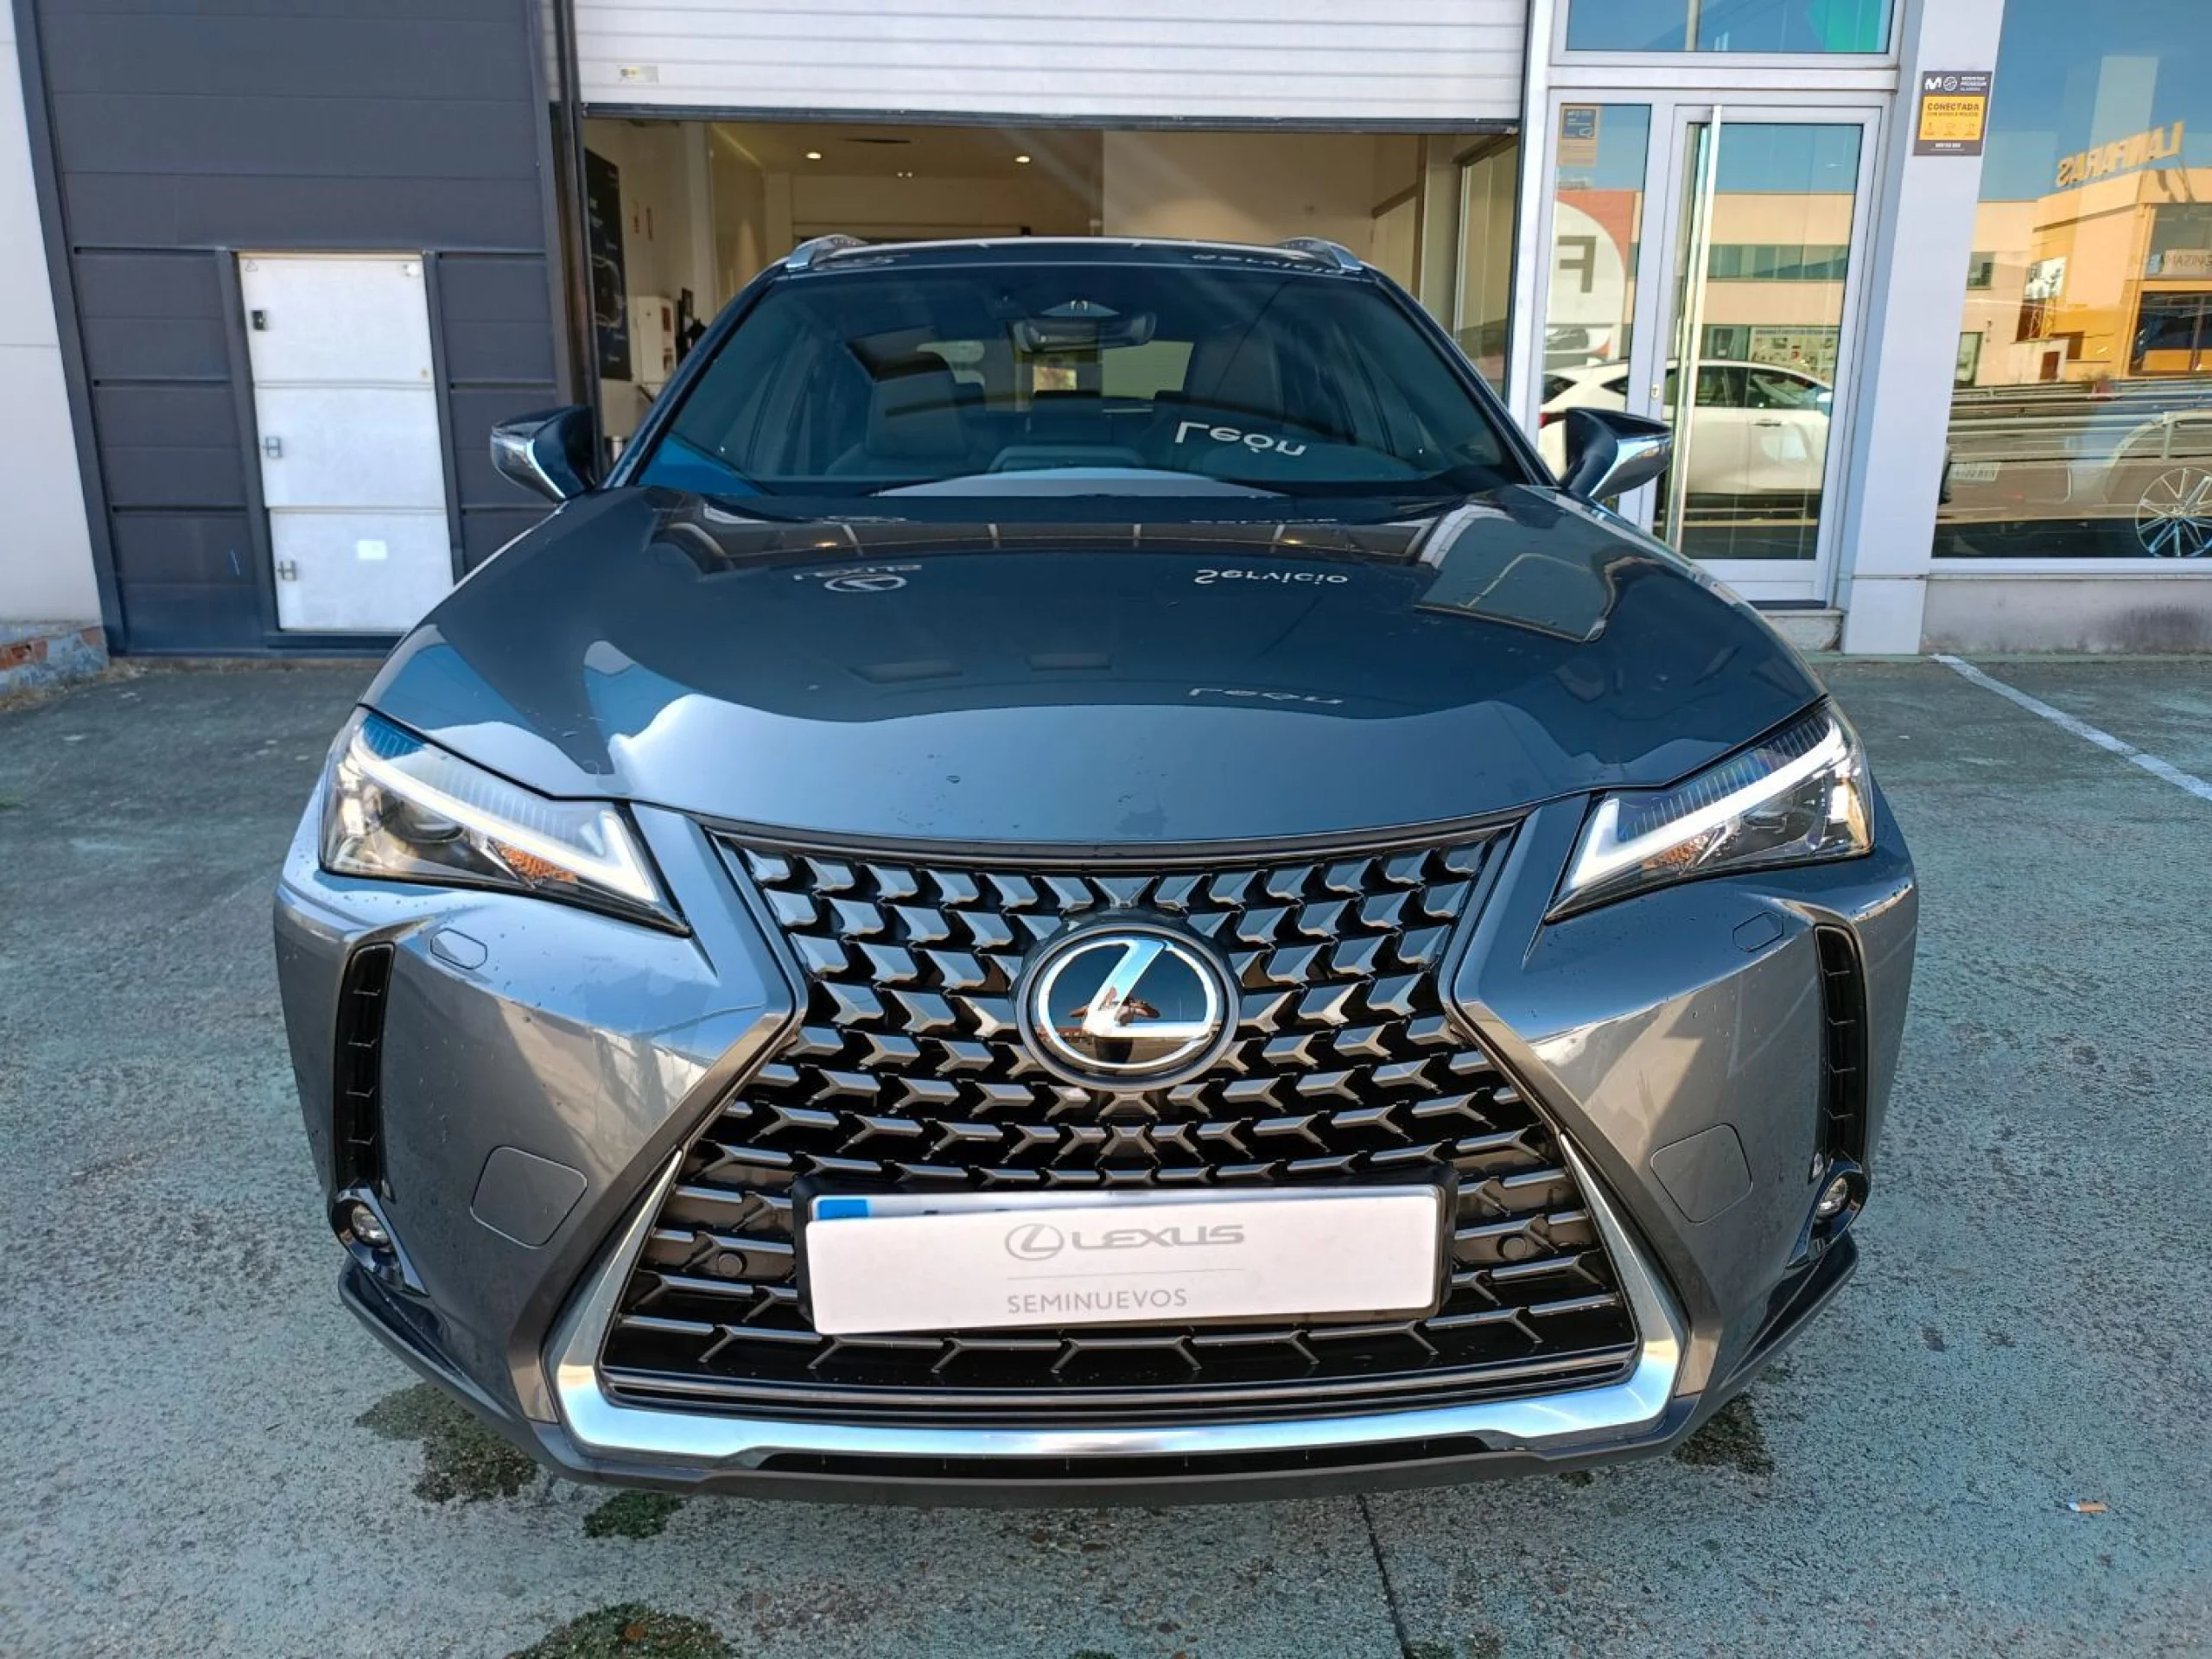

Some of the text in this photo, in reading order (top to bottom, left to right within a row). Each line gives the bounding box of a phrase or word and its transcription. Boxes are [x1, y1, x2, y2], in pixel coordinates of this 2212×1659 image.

[1927, 102, 1980, 111] CONECTADA
[1071, 1224, 1245, 1251] LEXUS
[1007, 1288, 1188, 1314] SEMINUEVOS
